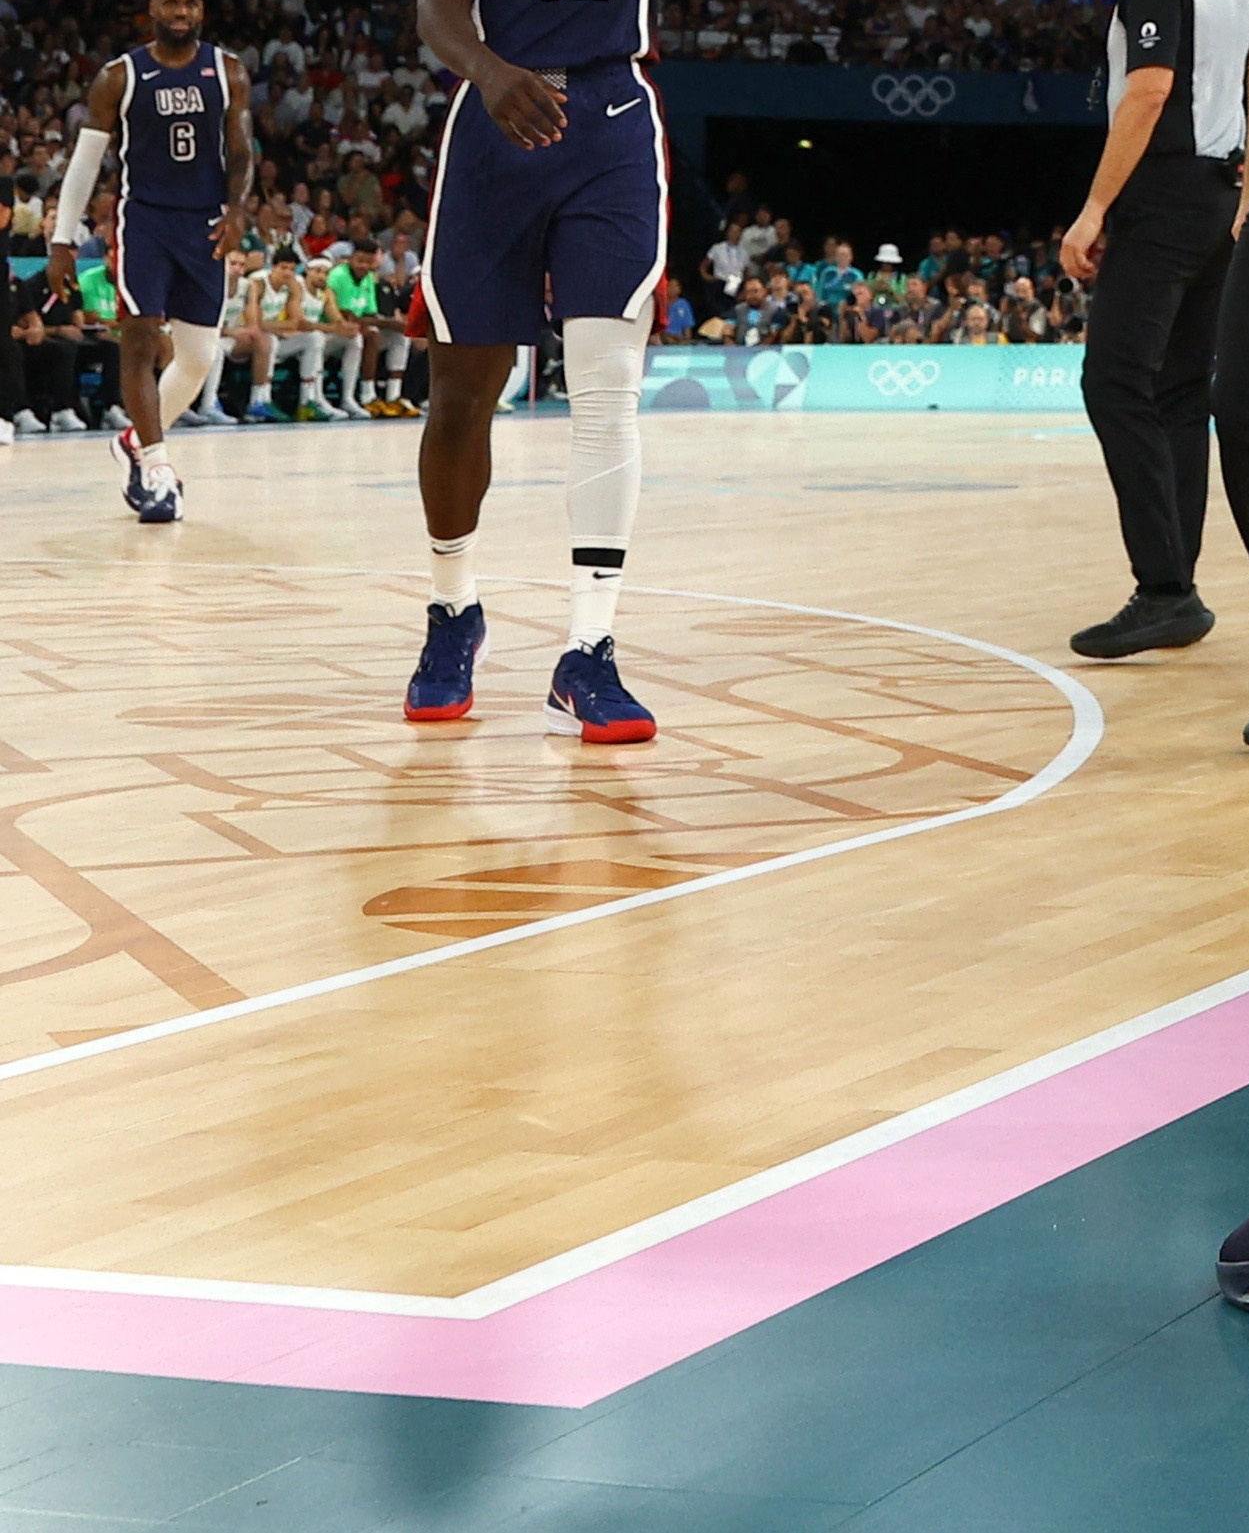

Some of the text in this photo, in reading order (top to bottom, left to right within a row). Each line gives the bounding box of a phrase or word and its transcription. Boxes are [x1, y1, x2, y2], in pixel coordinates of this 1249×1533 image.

[155, 85, 205, 116] USA
[169, 121, 196, 162] 6
[1011, 367, 1078, 387] PARI
